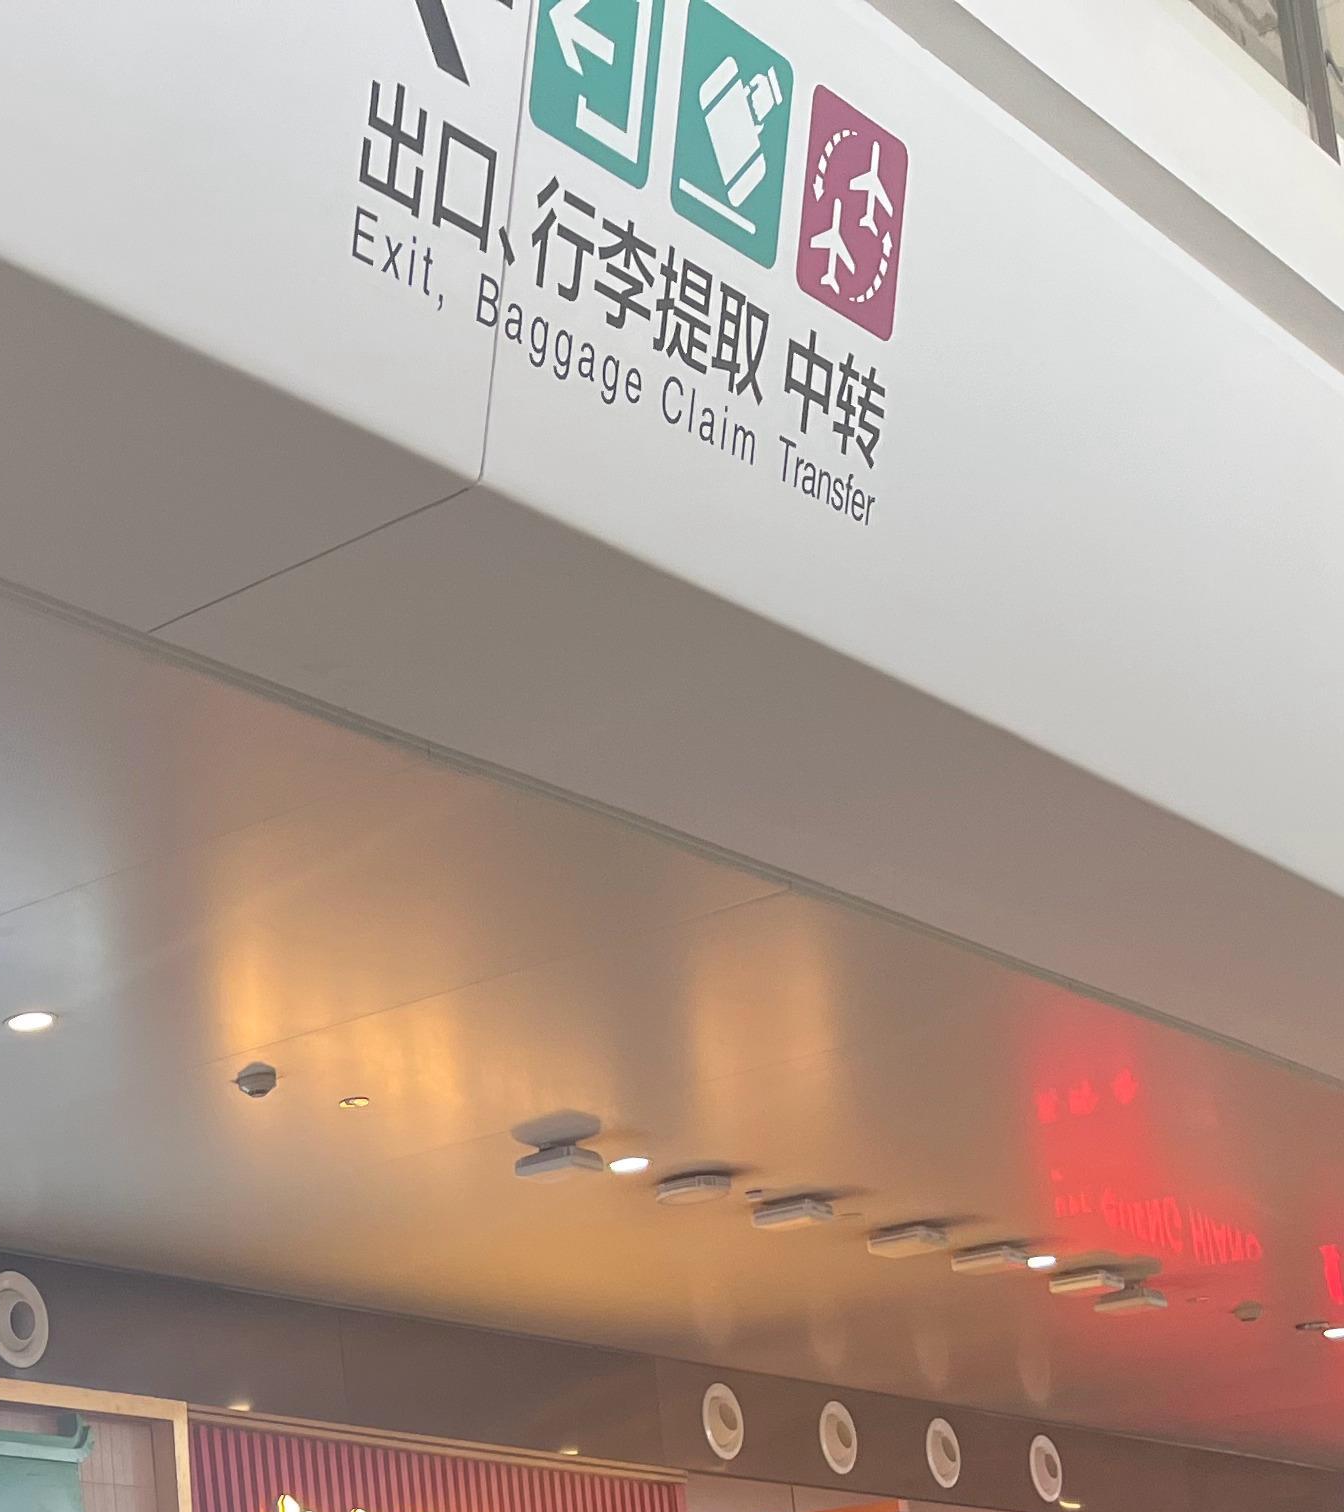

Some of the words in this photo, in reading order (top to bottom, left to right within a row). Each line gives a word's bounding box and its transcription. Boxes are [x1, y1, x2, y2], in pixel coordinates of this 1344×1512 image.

[351, 206, 444, 310] Exit,
[476, 272, 643, 405] Baggage
[662, 377, 756, 466] Claim
[779, 436, 875, 526] Transfer
[358, 80, 769, 405] 出口、行李提取
[784, 331, 886, 469] 中转
